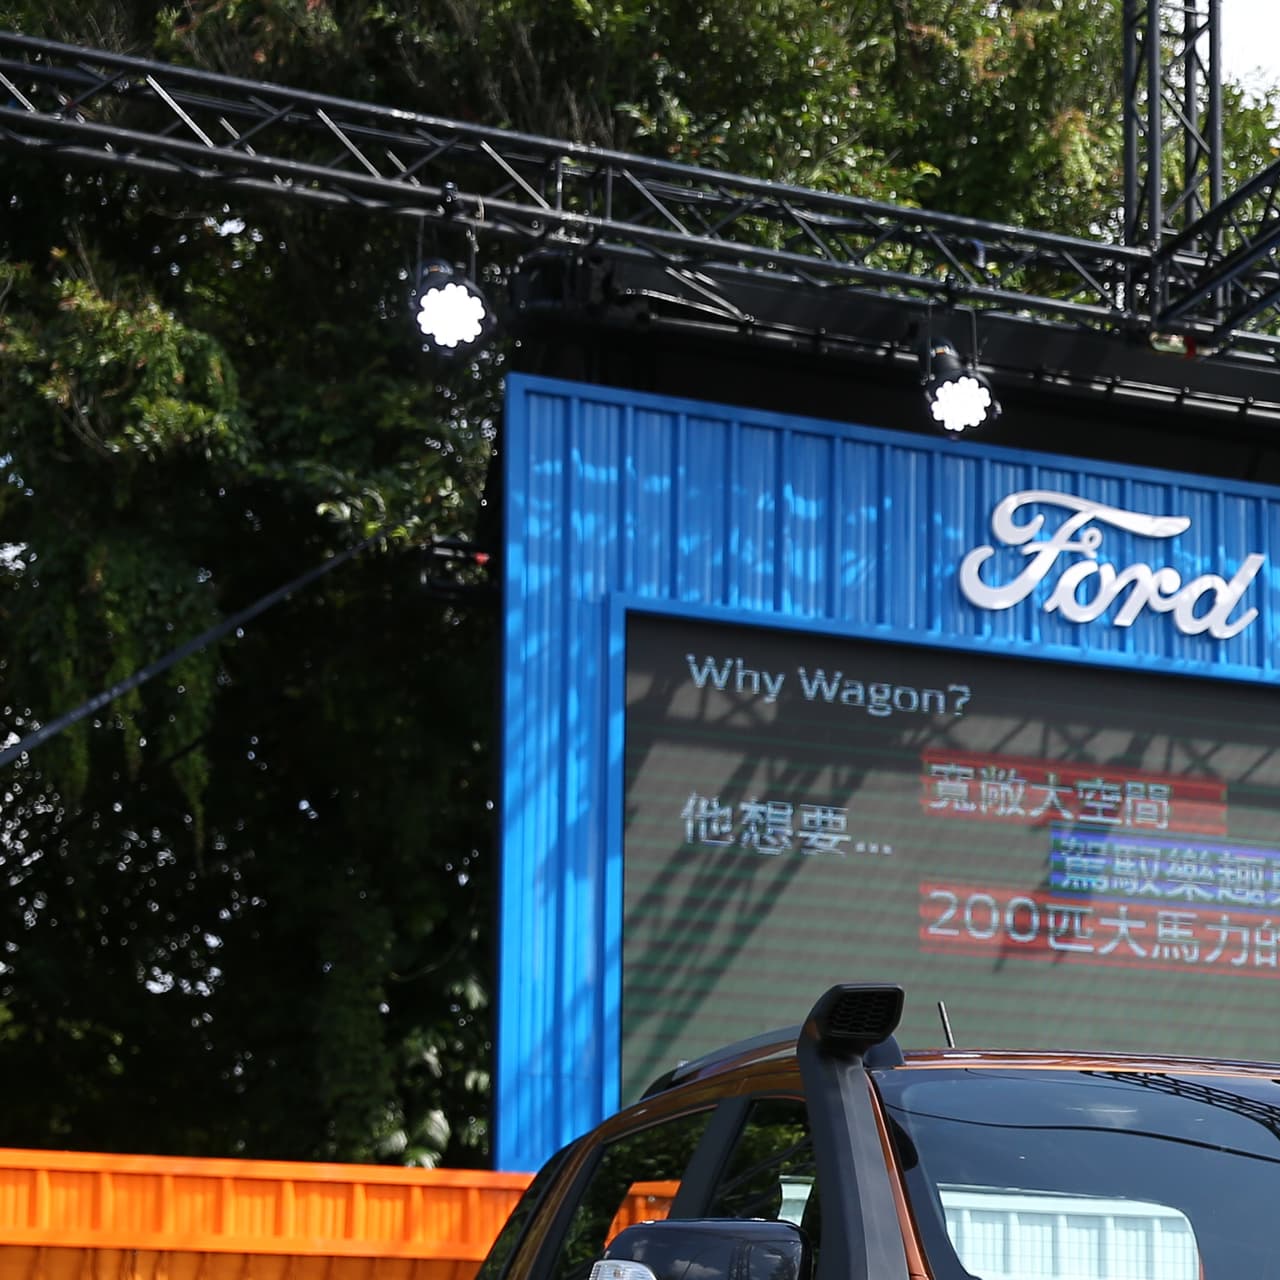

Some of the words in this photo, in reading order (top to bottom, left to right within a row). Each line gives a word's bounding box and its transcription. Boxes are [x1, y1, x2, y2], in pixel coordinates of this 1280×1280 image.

[960, 490, 1266, 639] Ford
[685, 653, 785, 704] Why
[797, 666, 972, 717] Wagon?
